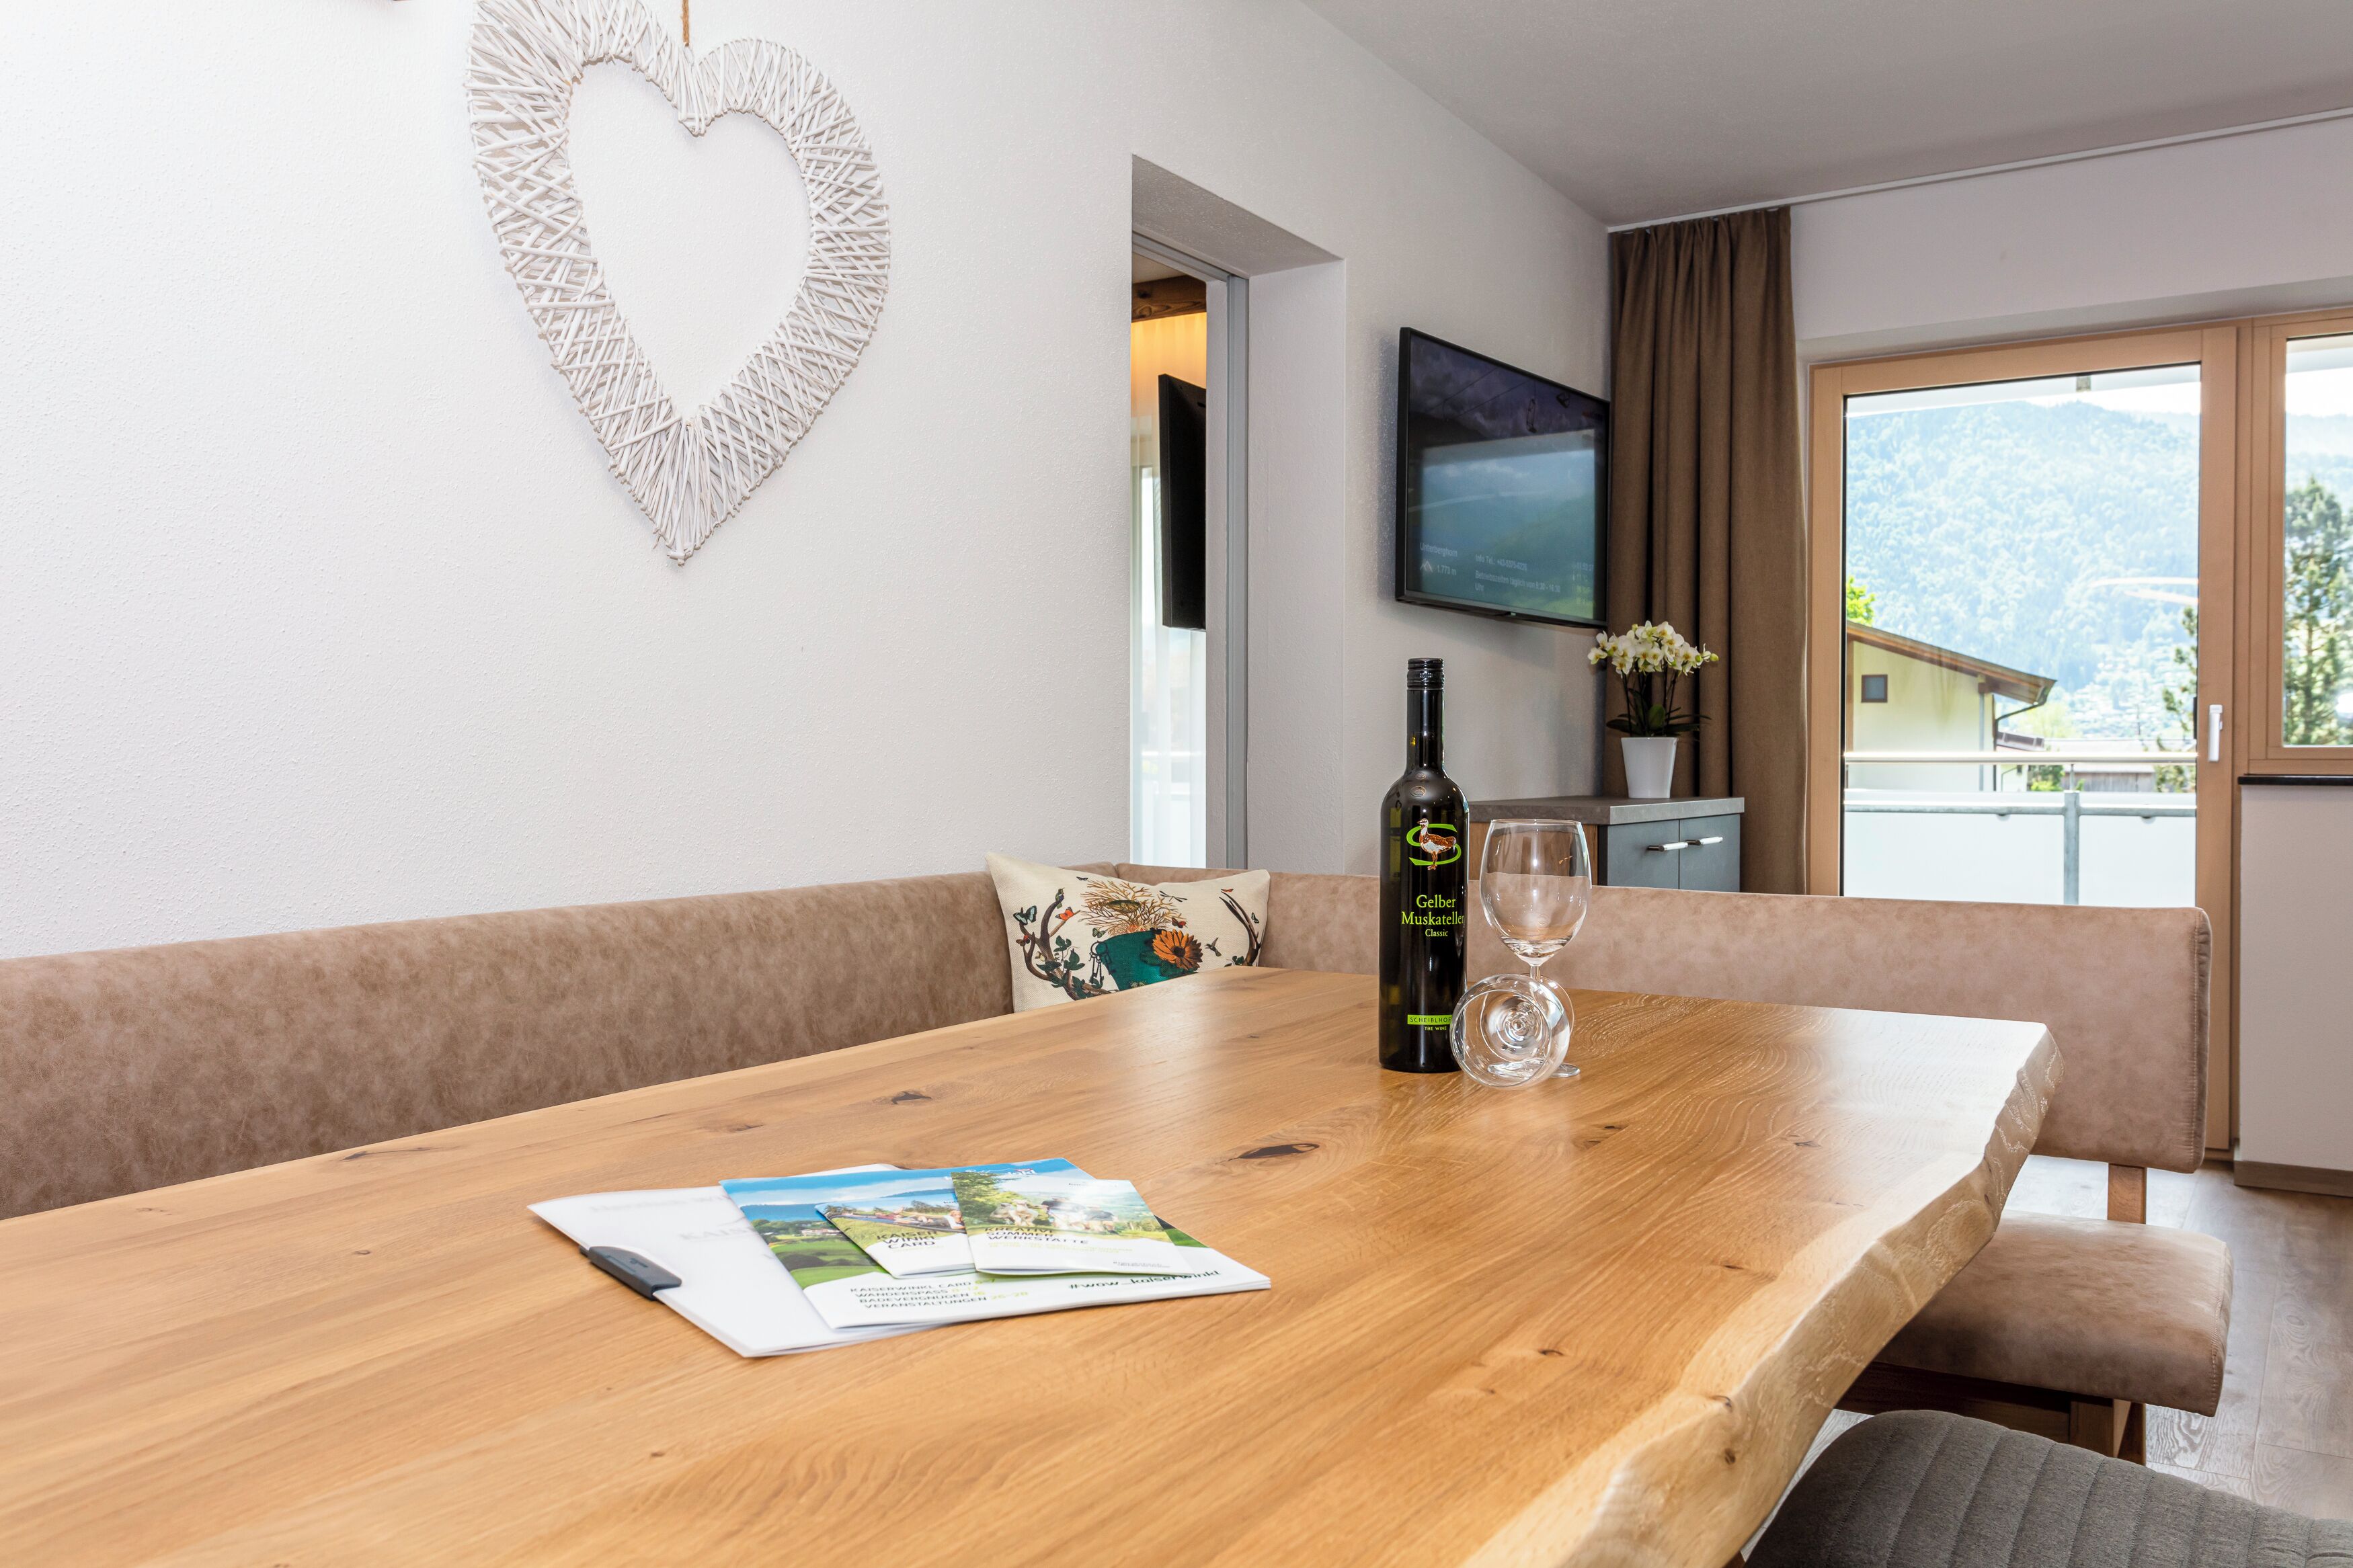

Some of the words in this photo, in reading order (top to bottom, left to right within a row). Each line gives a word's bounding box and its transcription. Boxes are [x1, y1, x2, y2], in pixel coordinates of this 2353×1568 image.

[1416, 895, 1456, 908] Gelber
[1401, 911, 1465, 925] Muskateller
[1425, 928, 1449, 937] Classic
[877, 1231, 938, 1240] KAISER
[888, 1241, 935, 1249] CARD
